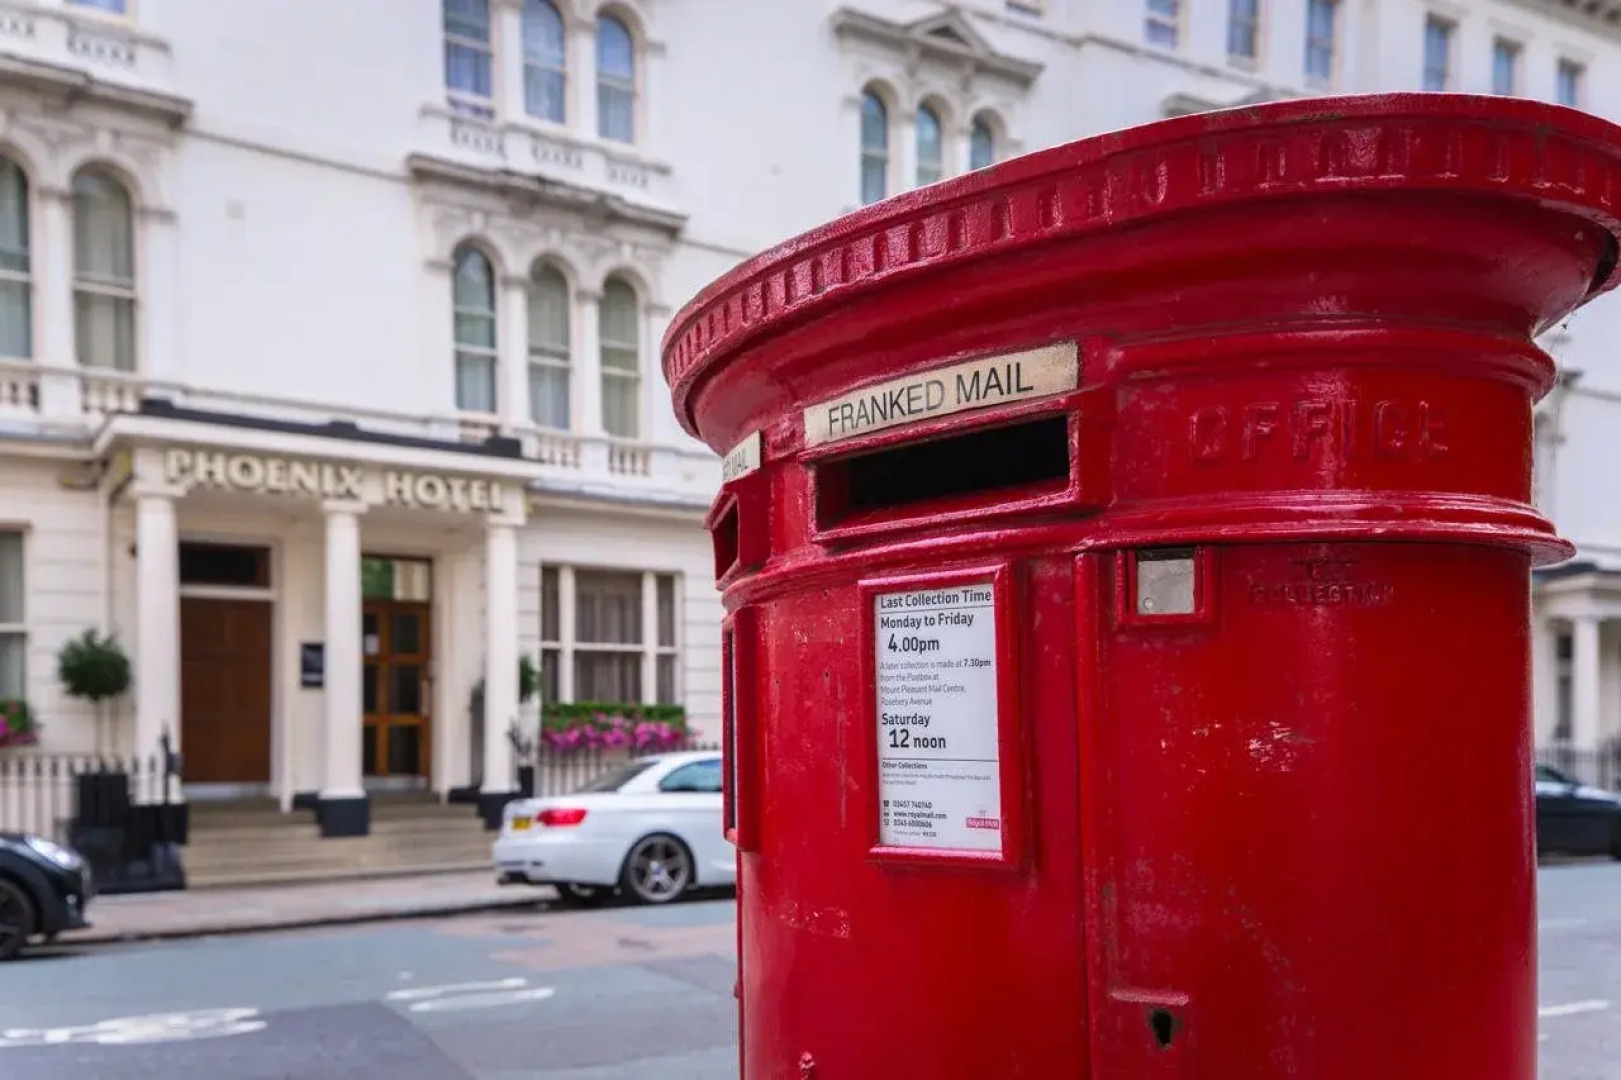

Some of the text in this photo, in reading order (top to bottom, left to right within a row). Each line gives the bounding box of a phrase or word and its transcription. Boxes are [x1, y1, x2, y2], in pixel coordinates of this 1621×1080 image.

[829, 361, 1035, 437] FRANKED MAIL
[1189, 398, 1449, 461] OFFICE
[164, 447, 505, 514] PHOENIX HOTEL
[881, 589, 992, 609] Last Collection Time
[880, 611, 975, 630] Monday to Friday
[888, 633, 940, 654] 4.00pm
[963, 658, 991, 669] 7.30pm
[901, 685, 928, 694] Pleasant
[929, 684, 942, 693] Mail
[882, 712, 931, 727] Saturday
[889, 728, 947, 749] 12 noon
[882, 761, 928, 770] Other Collections
[893, 811, 947, 820] www.royalmail.com
